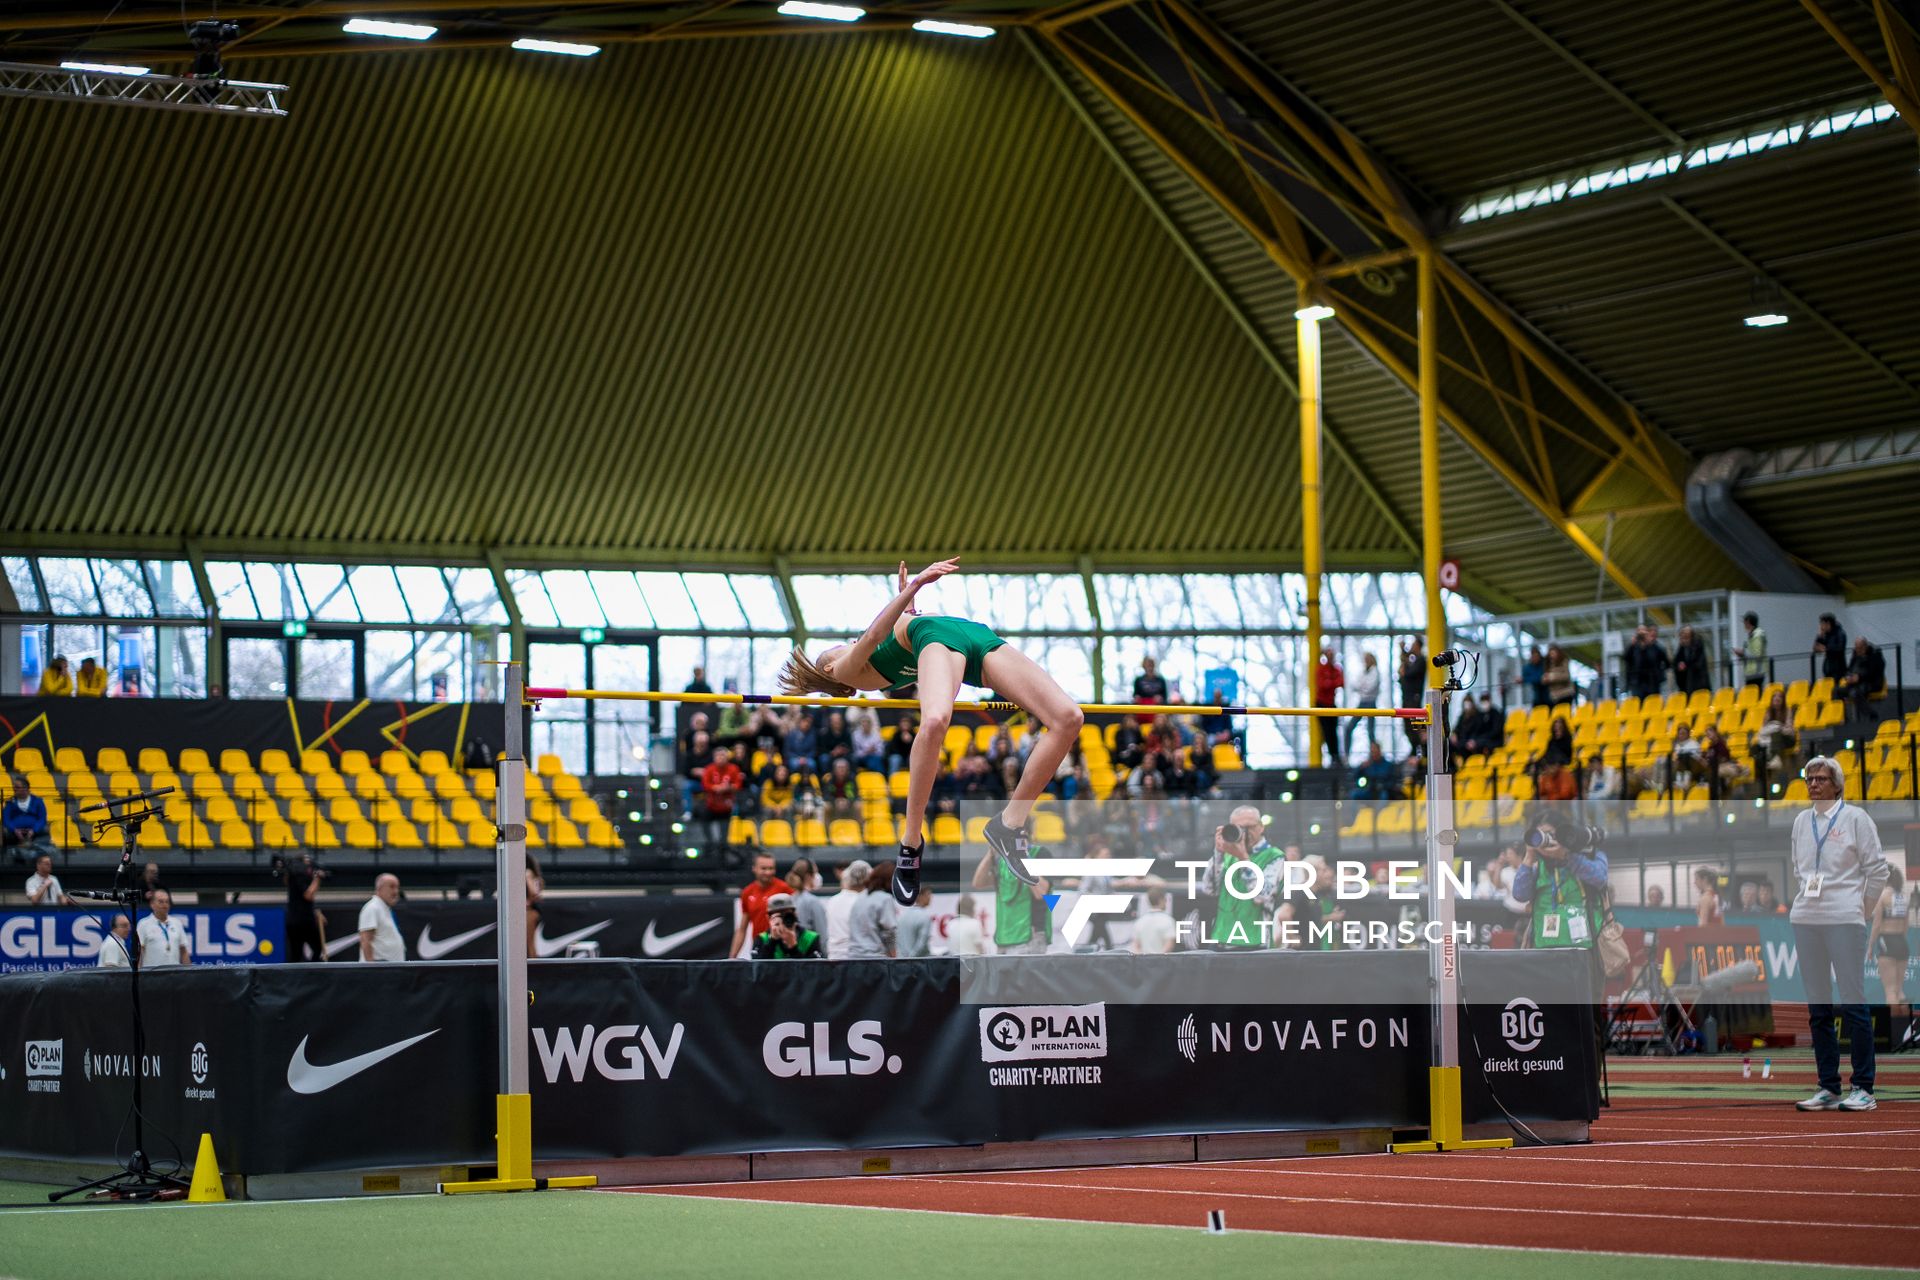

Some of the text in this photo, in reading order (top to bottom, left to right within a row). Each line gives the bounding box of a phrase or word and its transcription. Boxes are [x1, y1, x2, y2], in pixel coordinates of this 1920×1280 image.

[1443, 934, 1454, 978] BENZ
[1031, 1015, 1101, 1039] PLAN
[1211, 1016, 1409, 1054] NOVAFON
[1501, 1010, 1544, 1039] BIG
[41, 1047, 61, 1062] PLAN
[531, 1021, 684, 1084] WGV
[763, 1020, 903, 1078] GLS.
[1032, 1042, 1101, 1051] INTERNATIONAL
[191, 1052, 208, 1074] BIG
[1484, 1056, 1564, 1075] direkt gesund
[989, 1066, 1102, 1086] CHARITY-PARTNER
[185, 1087, 215, 1101] direkt gesund
